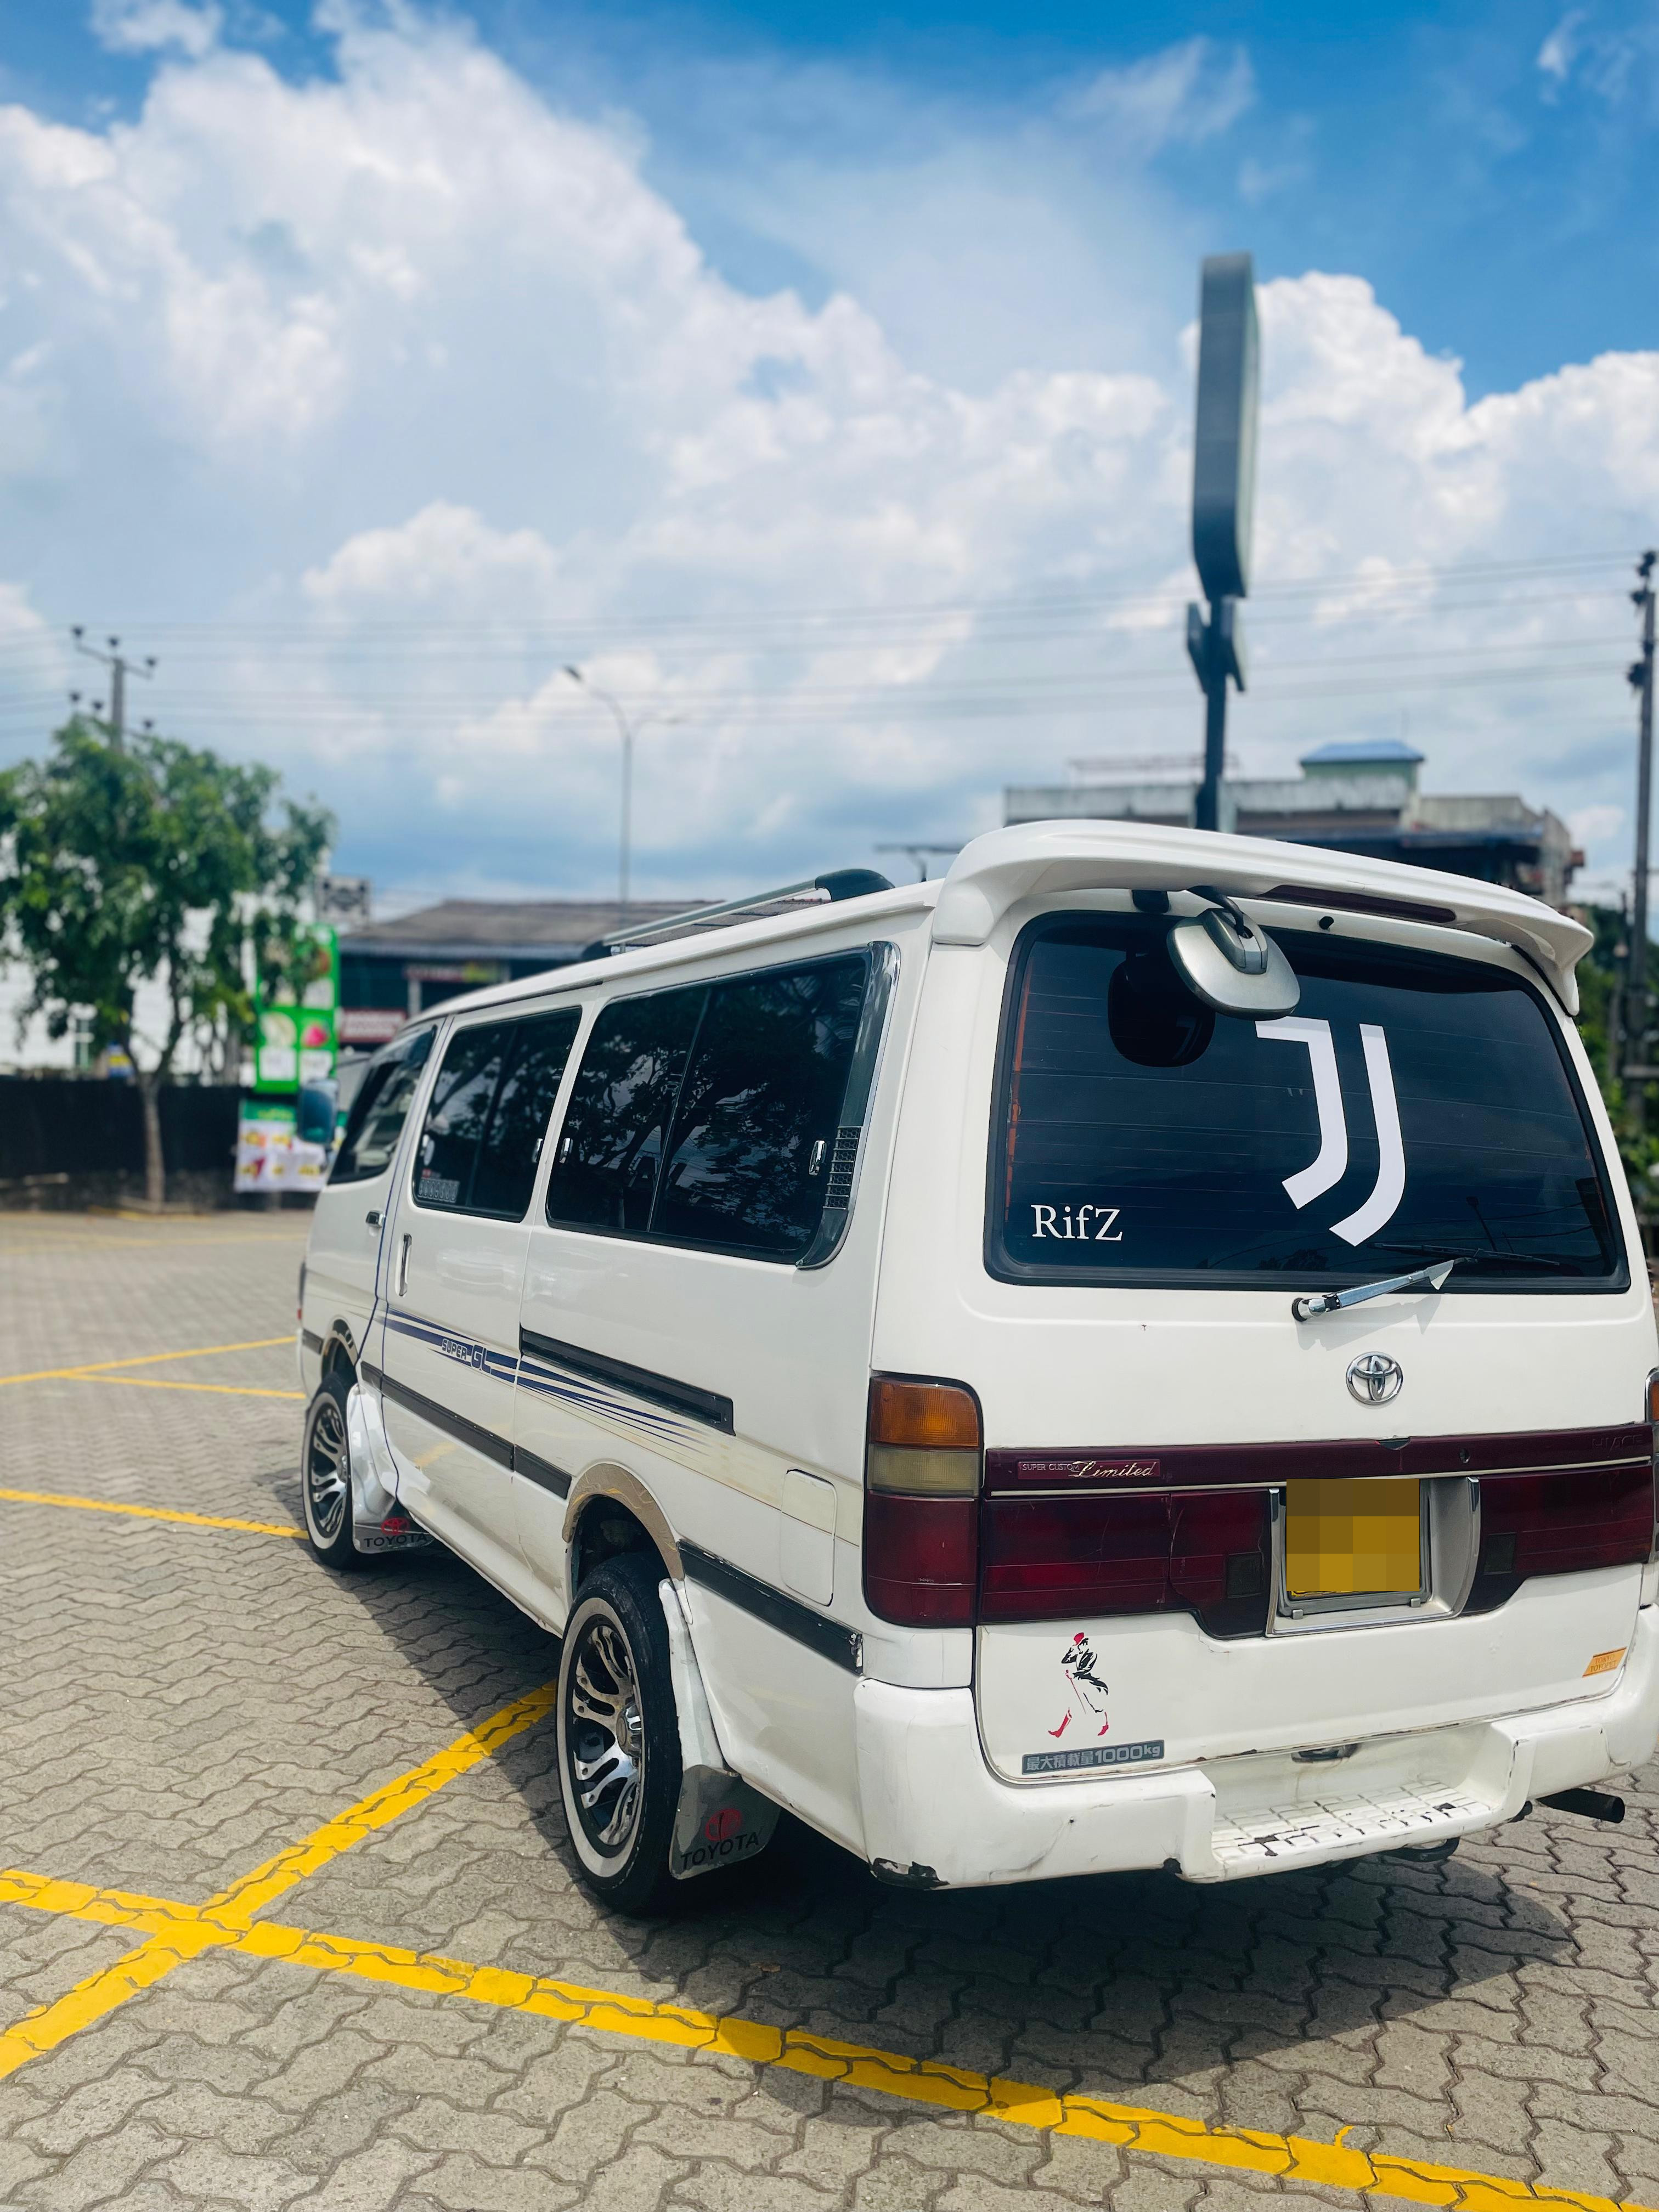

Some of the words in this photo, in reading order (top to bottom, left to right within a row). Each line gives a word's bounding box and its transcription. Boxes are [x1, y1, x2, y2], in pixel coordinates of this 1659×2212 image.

[1031, 1205, 1122, 1241] RifZ
[442, 1339, 467, 1361] SUPER
[471, 1345, 492, 1374] GL
[1022, 1463, 1046, 1471] SUPER
[1048, 1463, 1080, 1471] CUSTOM
[1068, 1460, 1155, 1478] Limited
[364, 1533, 427, 1548] TOYOTA
[681, 1831, 759, 1870] TOYOTA
